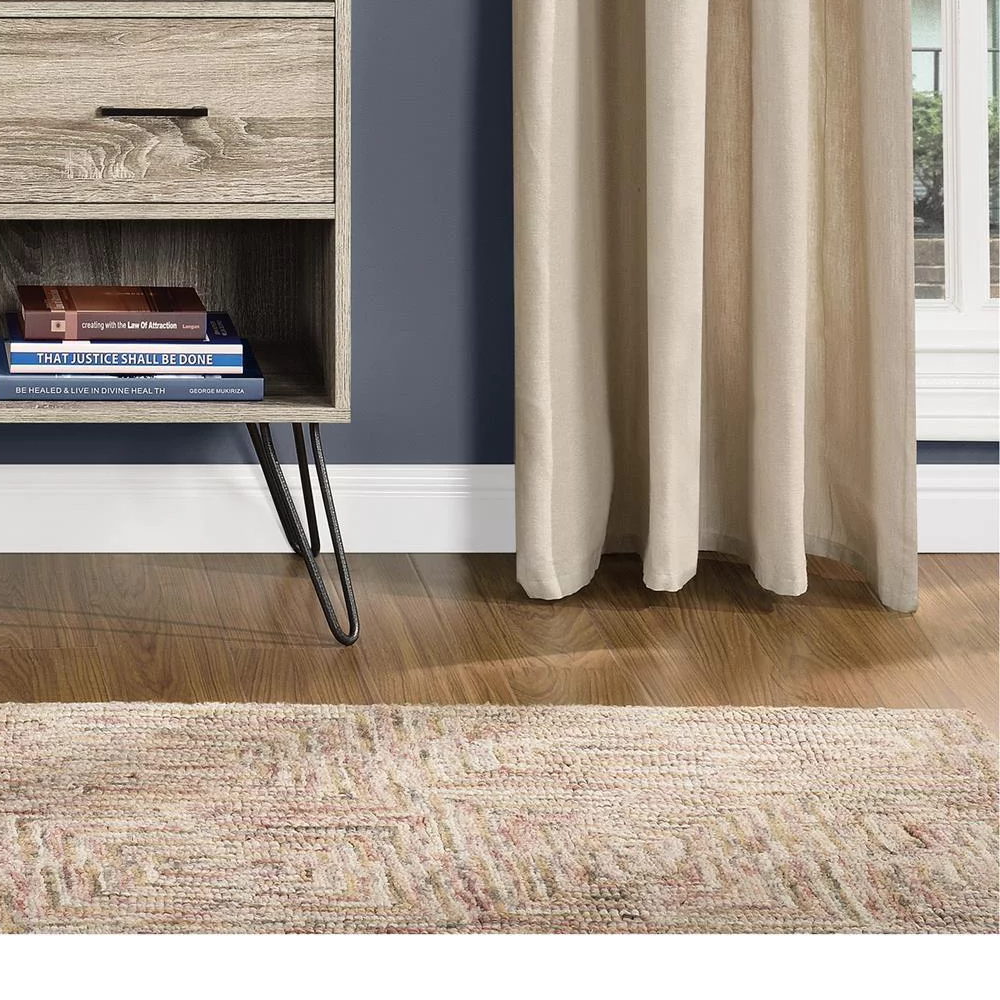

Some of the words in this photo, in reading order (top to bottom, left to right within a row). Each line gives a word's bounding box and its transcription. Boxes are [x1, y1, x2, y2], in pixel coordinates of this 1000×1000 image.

[82, 321, 104, 330] creating
[105, 321, 116, 329] with
[117, 321, 126, 329] the
[128, 321, 140, 329] Law
[141, 321, 148, 329] Of
[148, 321, 177, 329] Attraction
[37, 353, 69, 364] THAT
[71, 353, 118, 364] JUSTICE
[121, 354, 159, 365] SHALL
[162, 354, 176, 365] BE
[179, 354, 213, 365] DONE
